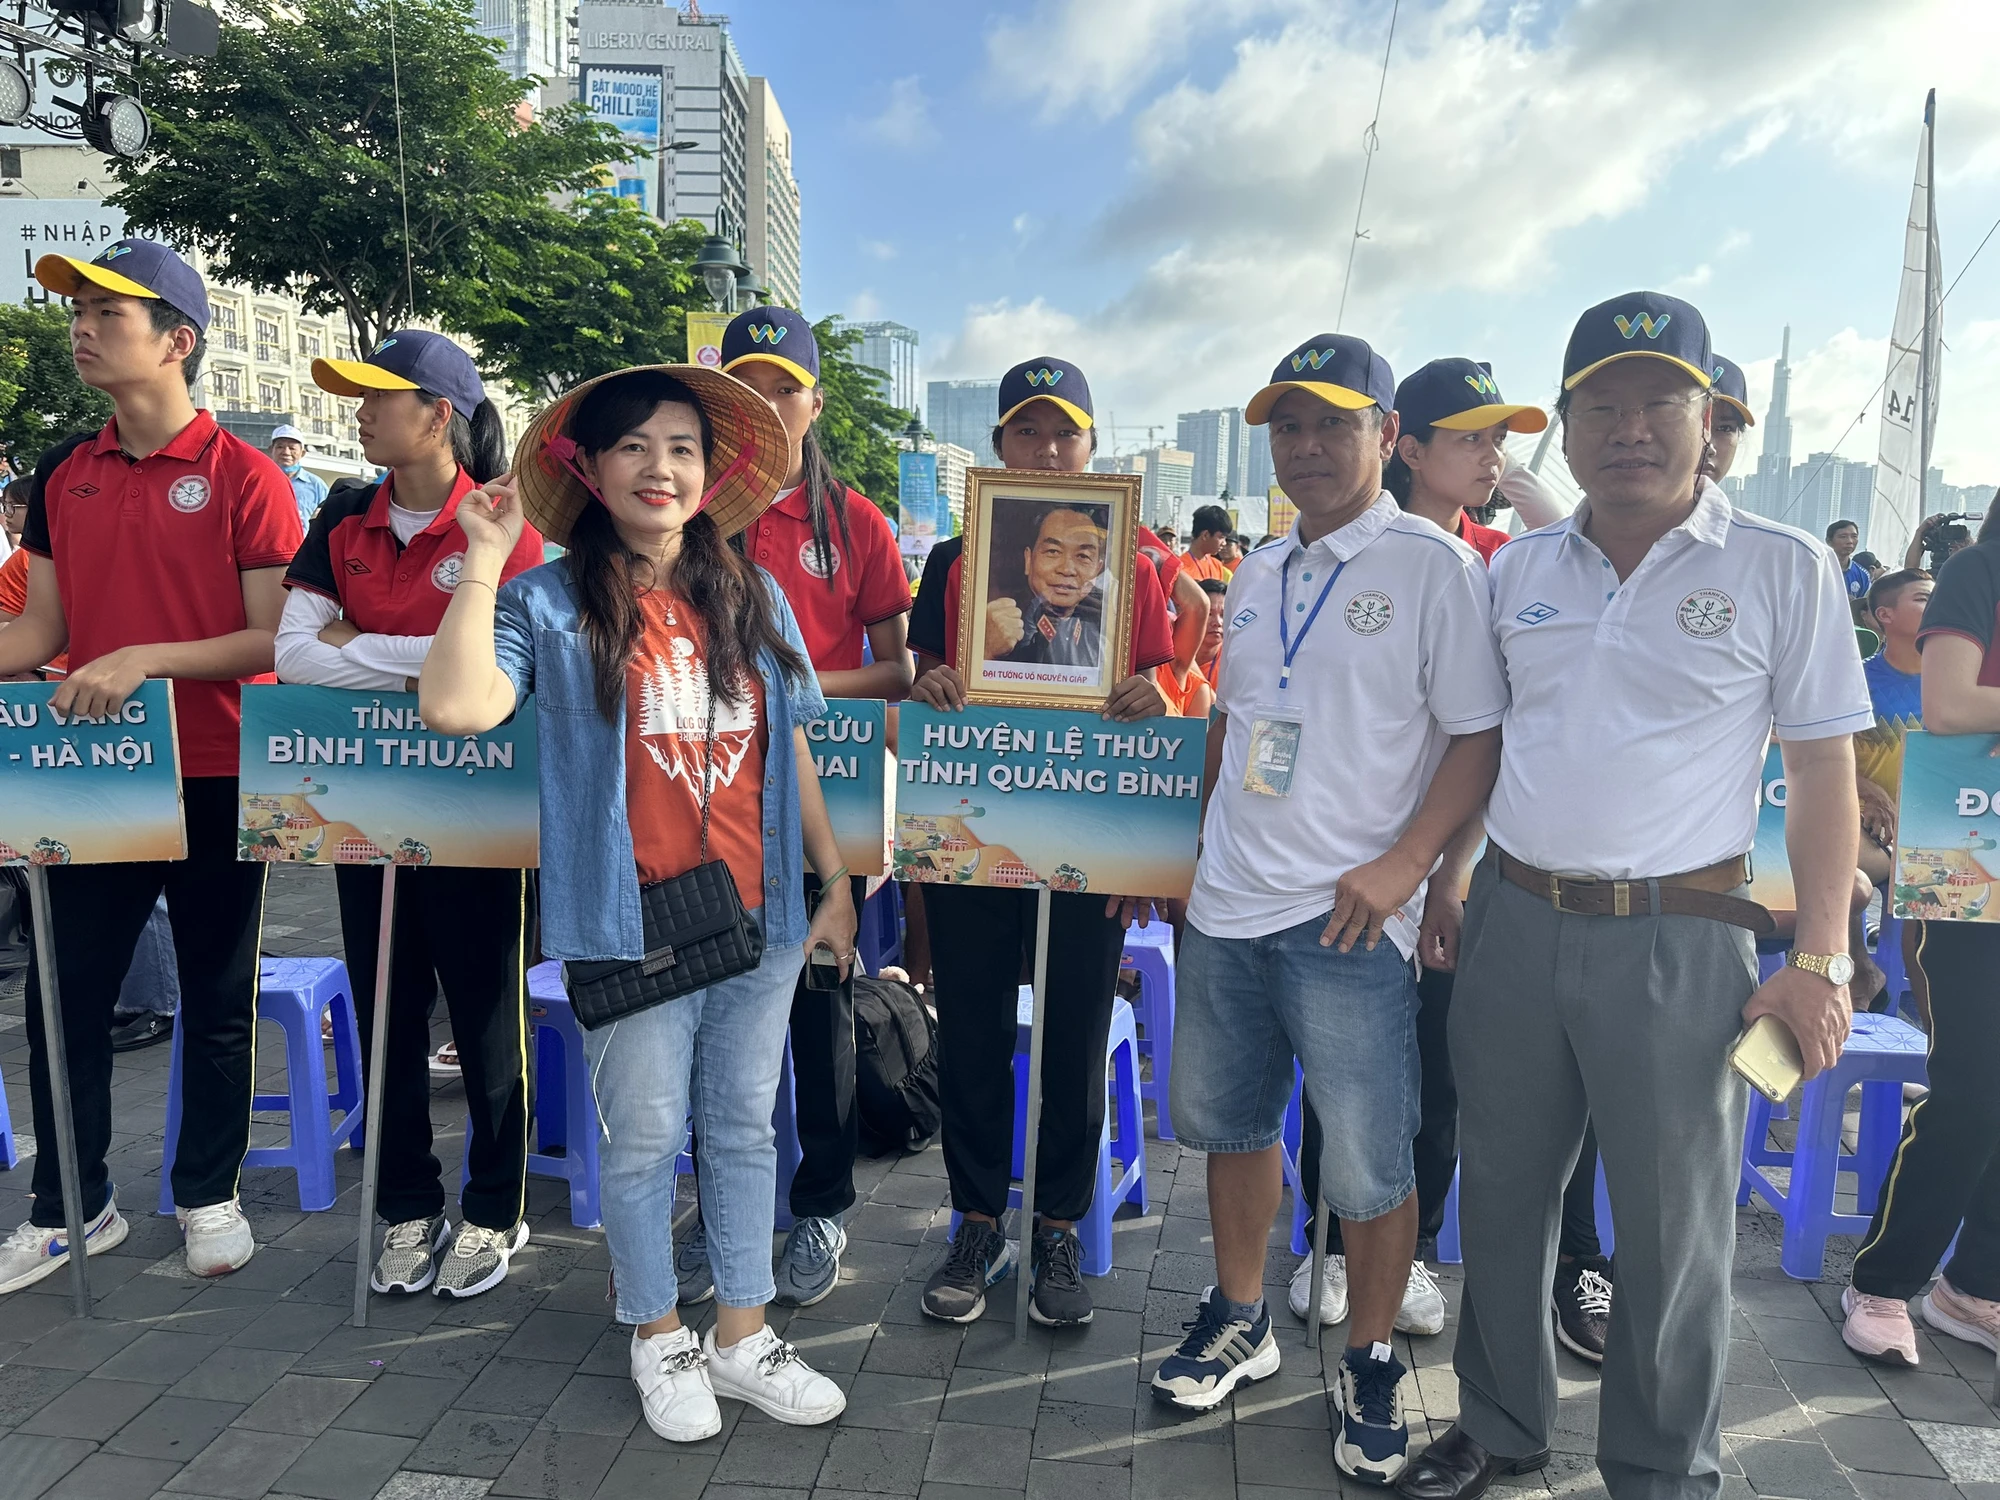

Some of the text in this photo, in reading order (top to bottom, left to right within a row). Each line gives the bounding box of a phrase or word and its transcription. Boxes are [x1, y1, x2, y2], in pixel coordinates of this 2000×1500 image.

[587, 32, 714, 51] LIBERTY CENTRAL
[612, 82, 642, 96] MOOD
[592, 95, 634, 116] CHILL
[21, 220, 111, 246] #NHẬP
[698, 716, 716, 729] OU
[806, 712, 873, 743] CỬU
[31, 738, 83, 767] HÀ
[91, 735, 153, 771] NỘI
[268, 729, 513, 775] BÌNH THUẬN
[923, 722, 1183, 761] HUYỆN LỆ THỦY
[901, 752, 1198, 798] TỈNH QUẢNG BÌNH
